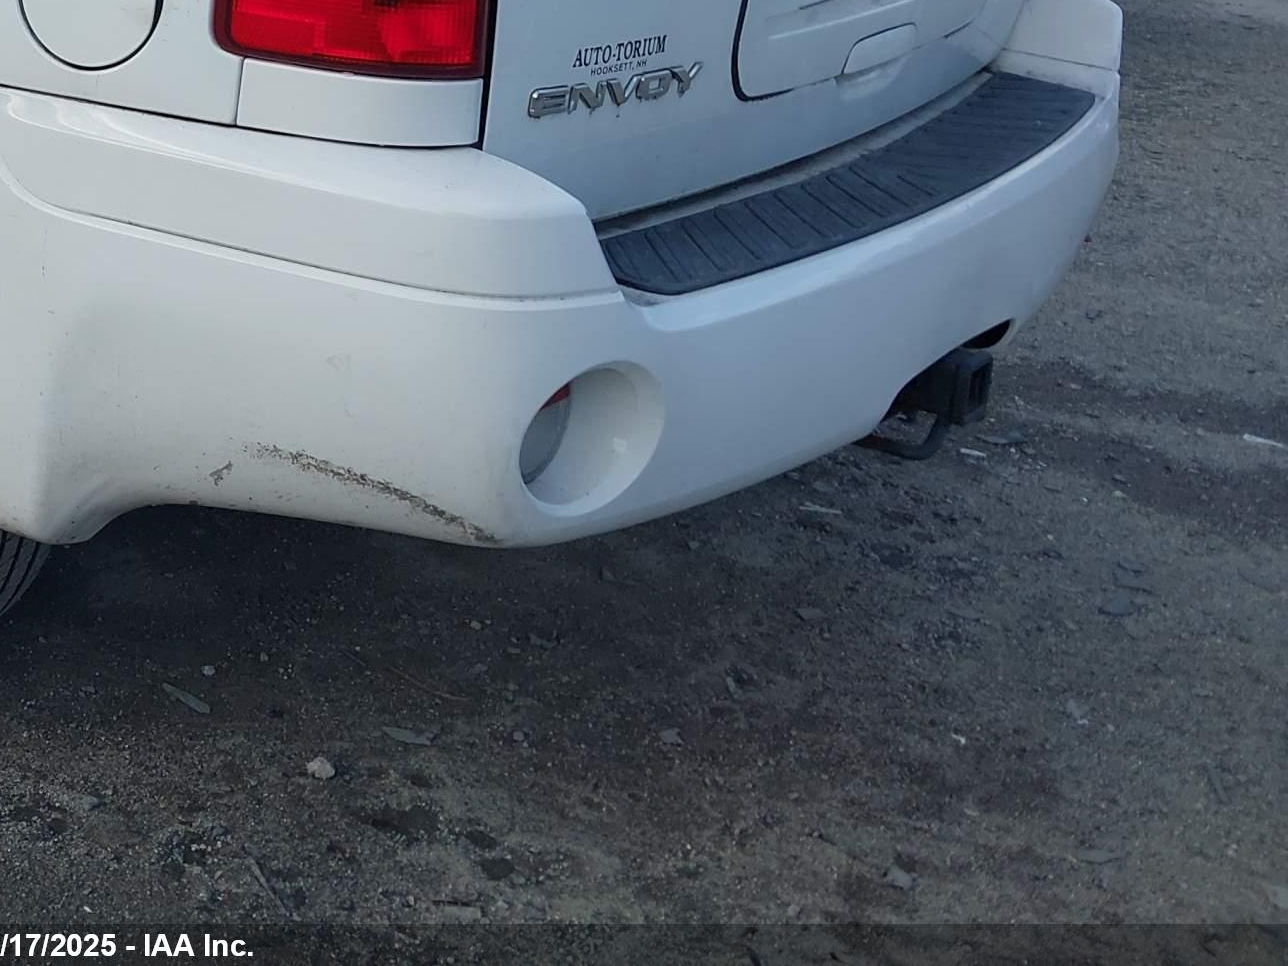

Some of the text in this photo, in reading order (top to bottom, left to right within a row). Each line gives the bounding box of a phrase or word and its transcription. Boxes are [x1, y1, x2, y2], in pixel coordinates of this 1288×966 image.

[572, 34, 667, 68] AUTO-TORIUM
[590, 59, 647, 76] HOOKSETT, NH
[526, 60, 705, 119] ENVOY
